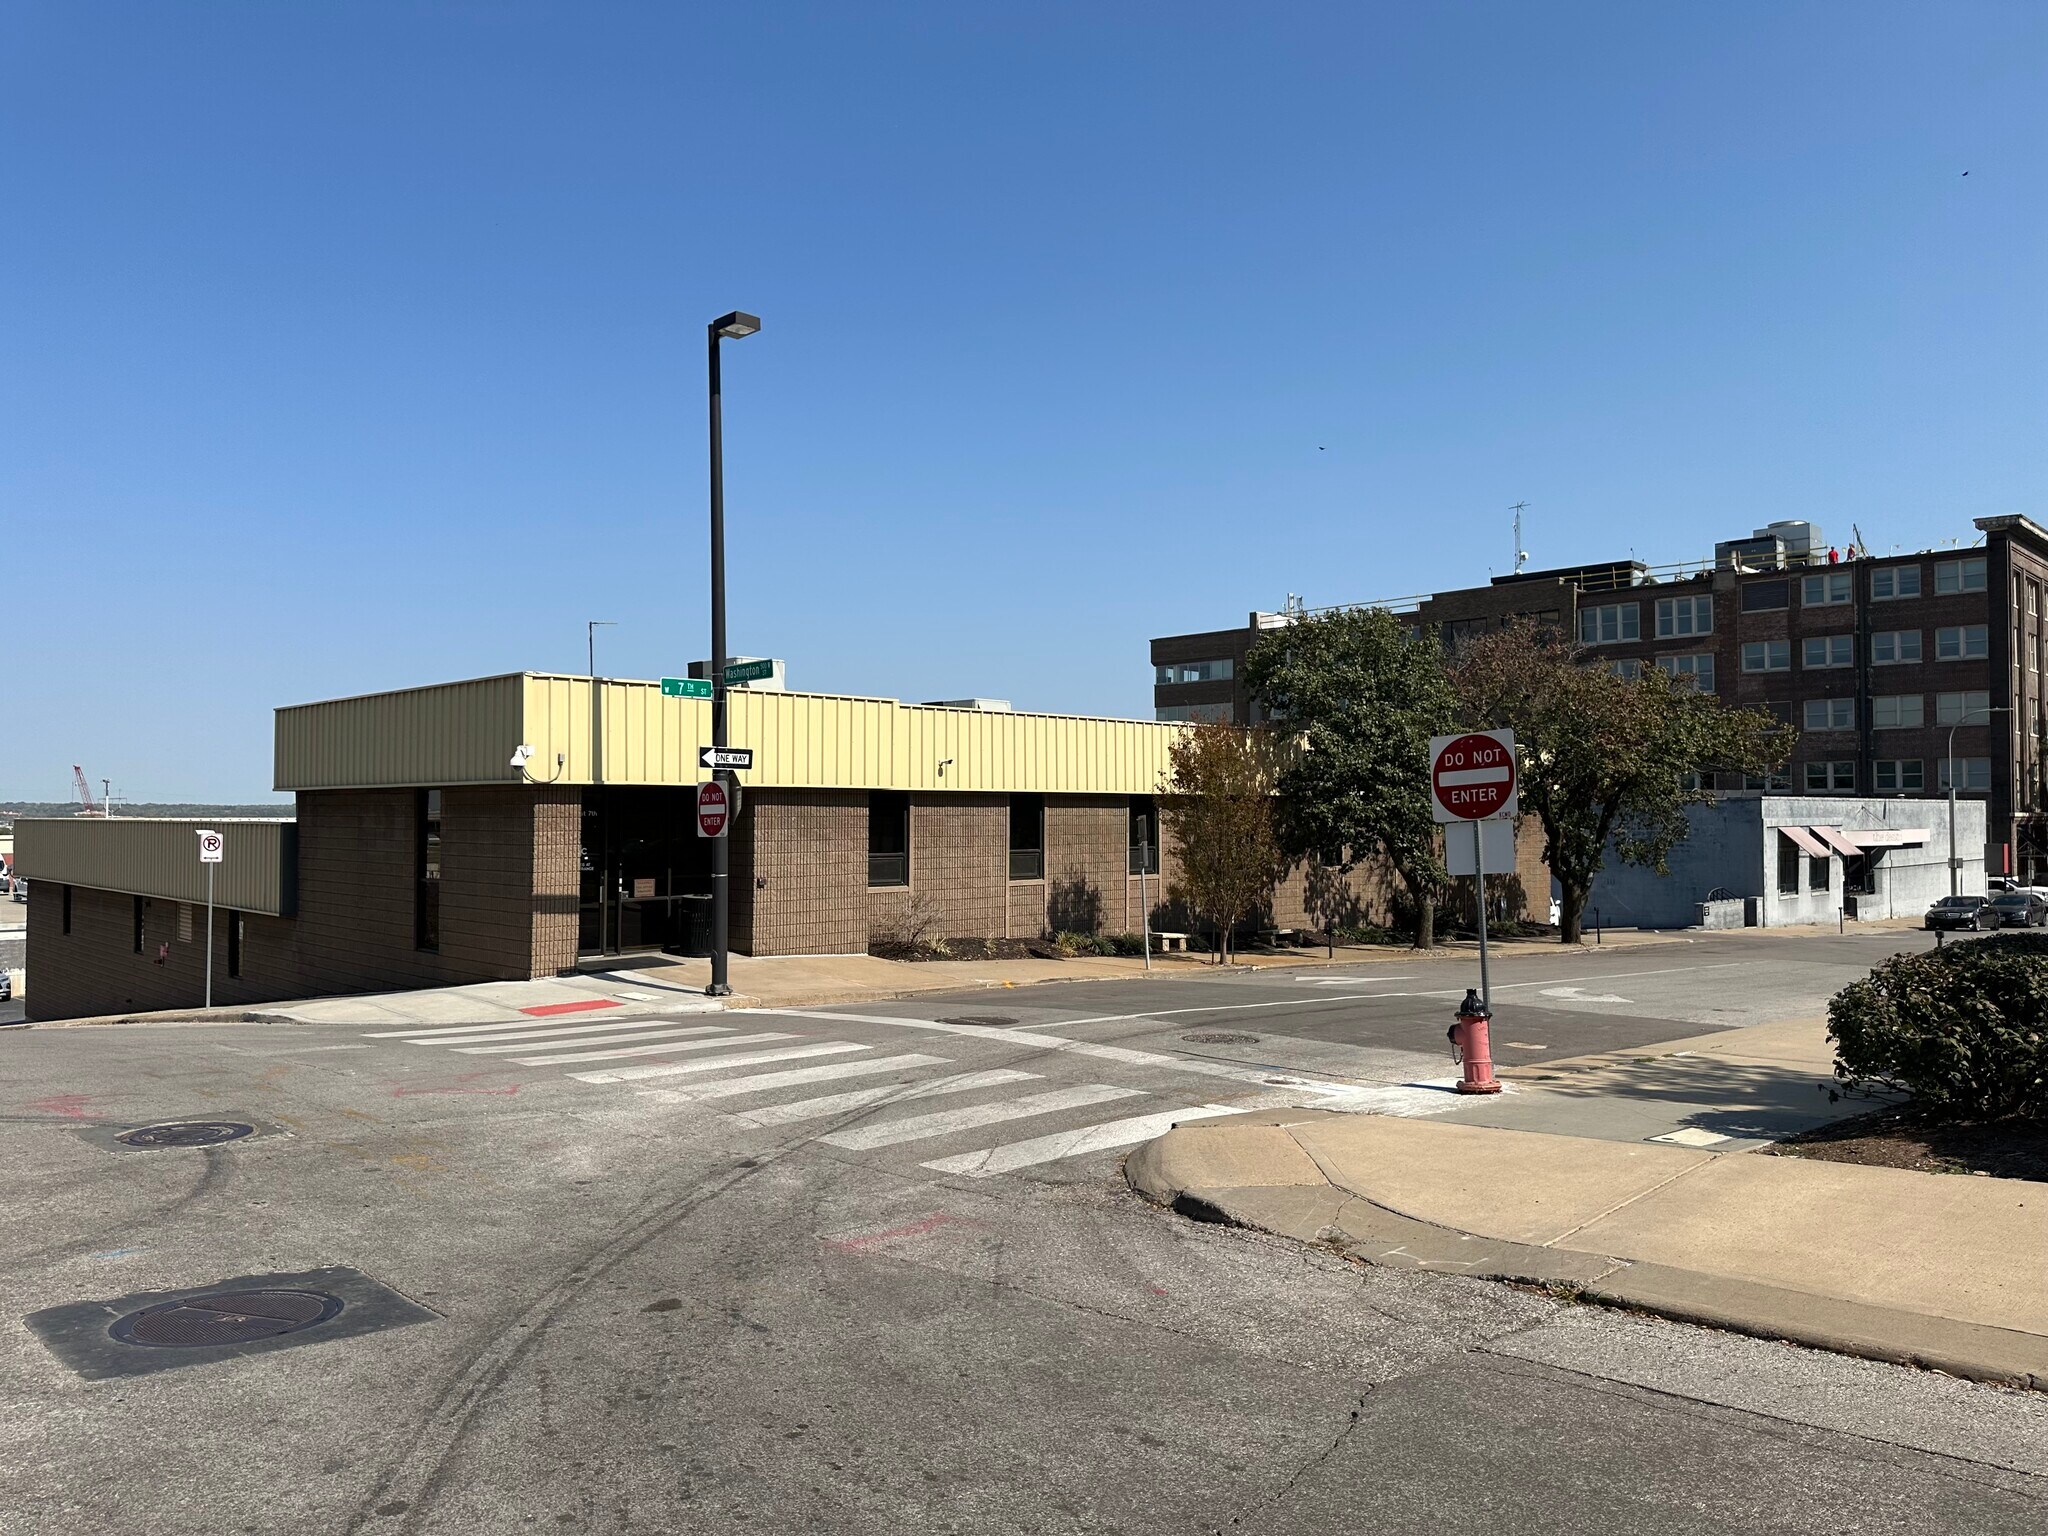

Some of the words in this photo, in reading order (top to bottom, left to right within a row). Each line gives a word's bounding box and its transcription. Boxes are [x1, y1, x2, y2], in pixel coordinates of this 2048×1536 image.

[725, 665, 760, 680] Washington
[715, 754, 730, 762] ONE
[732, 755, 747, 763] WAY
[1444, 752, 1464, 767] DO
[1473, 748, 1502, 764] NOT
[702, 793, 709, 802] DO
[711, 792, 722, 801] NOT
[1451, 788, 1497, 804] ENTER
[703, 817, 721, 826] ENTER
